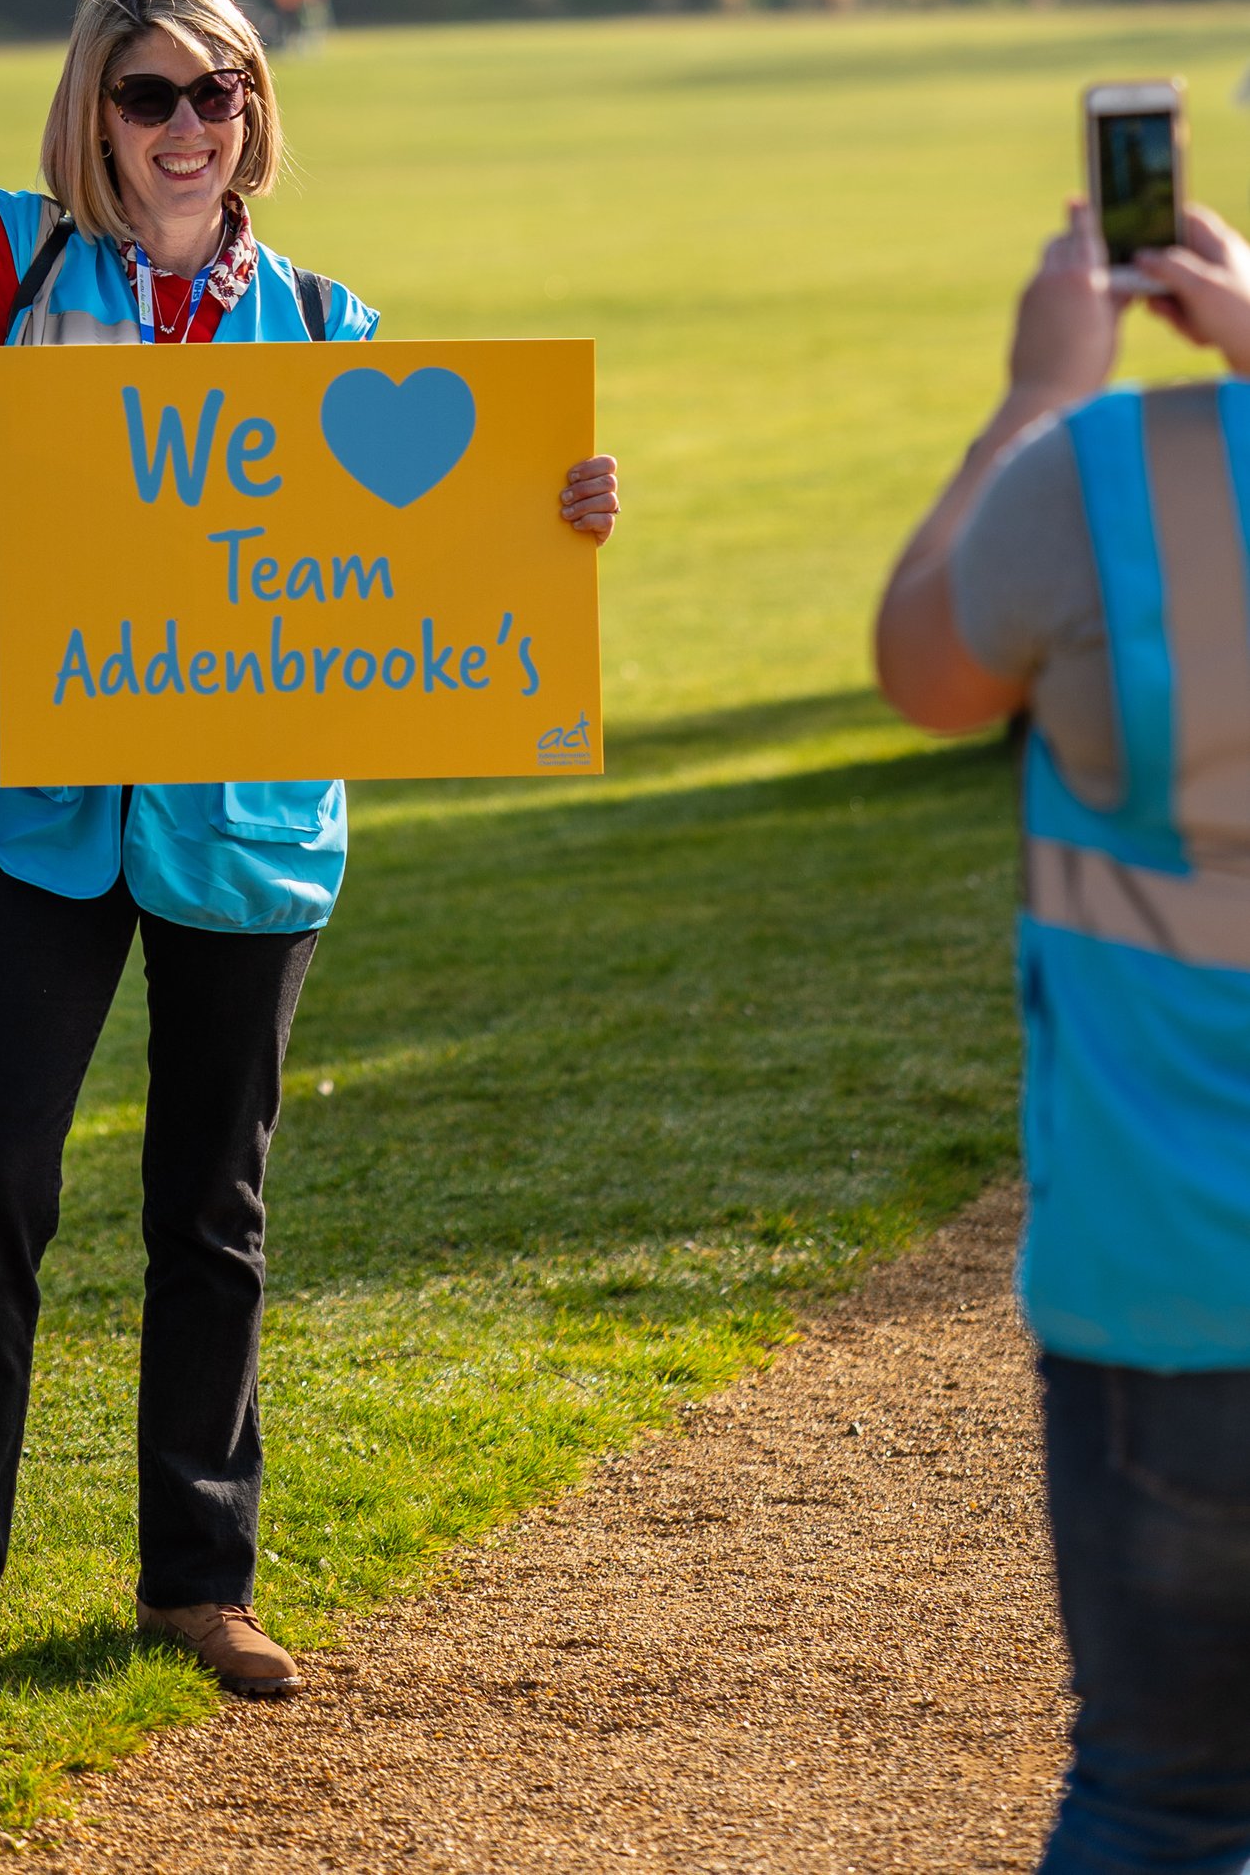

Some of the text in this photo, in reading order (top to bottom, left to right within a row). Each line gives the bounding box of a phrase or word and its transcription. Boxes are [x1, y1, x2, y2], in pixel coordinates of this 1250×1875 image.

[192, 280, 204, 300] NHS
[121, 385, 283, 508] We
[207, 526, 395, 605] Team
[53, 612, 540, 705] Addenbrooke's
[537, 711, 591, 750] act
